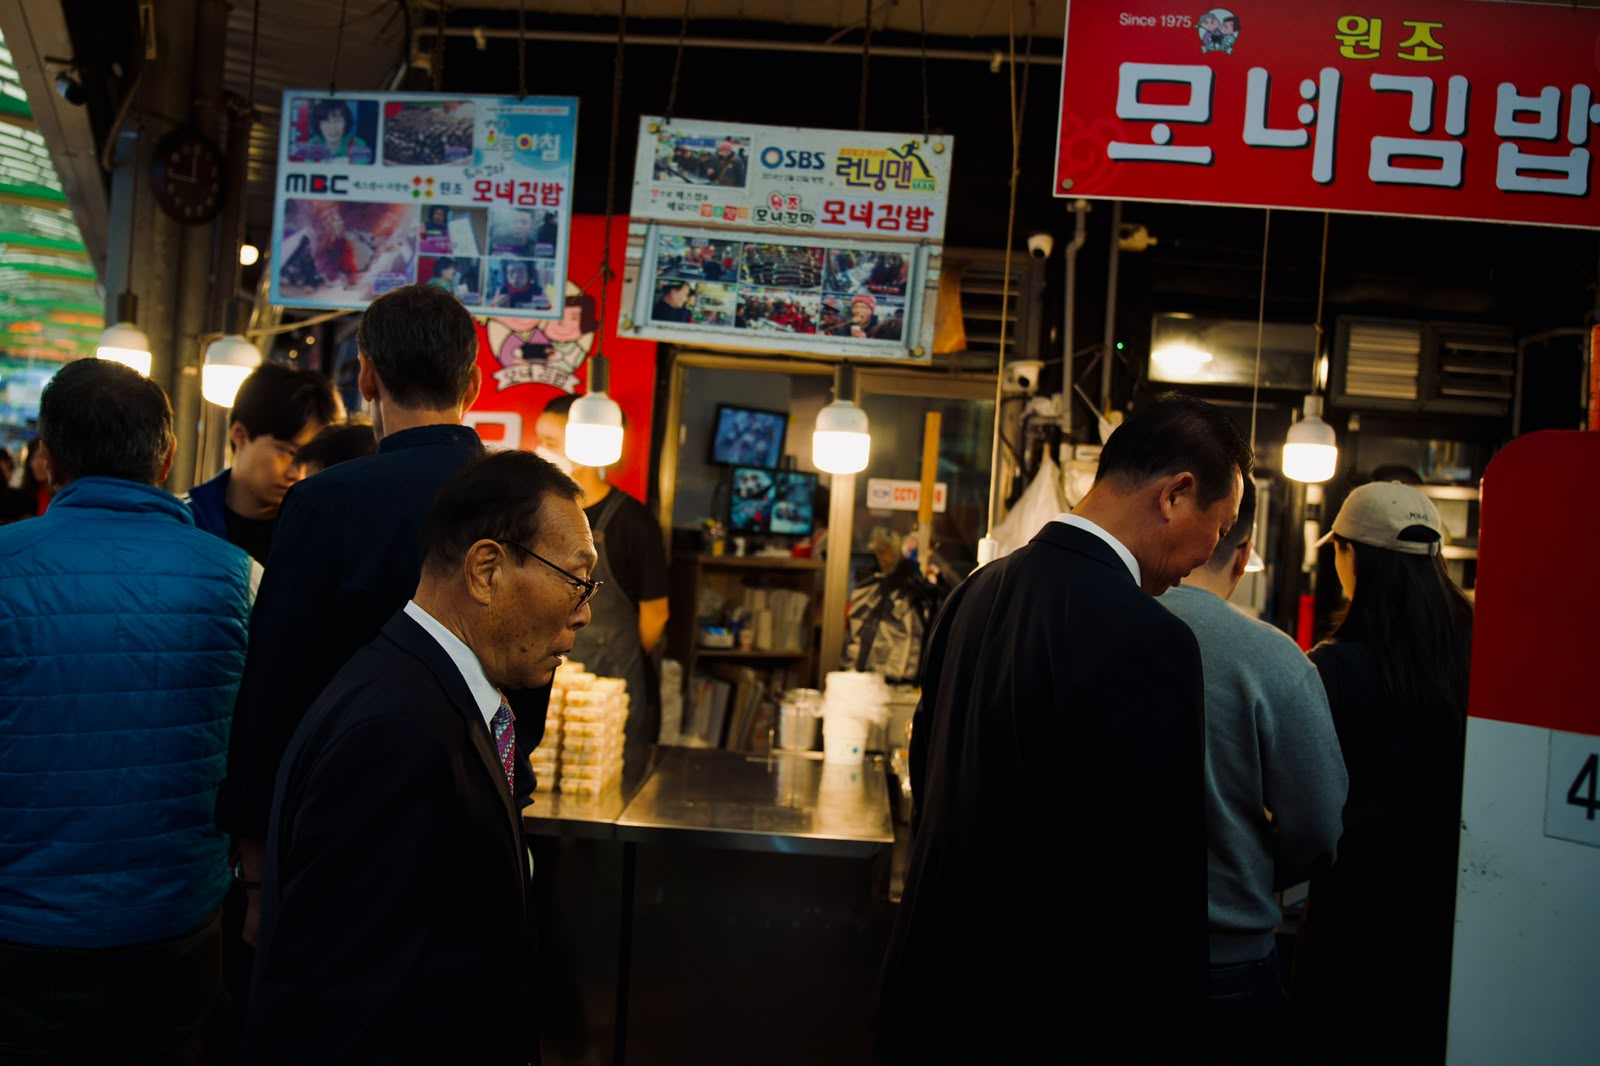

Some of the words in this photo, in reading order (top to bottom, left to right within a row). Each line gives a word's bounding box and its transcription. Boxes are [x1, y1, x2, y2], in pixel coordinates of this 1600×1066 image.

[1119, 12, 1156, 27] Since
[1159, 14, 1192, 28] 1975
[1334, 15, 1445, 61] 원조
[1107, 62, 1600, 196] 모녀김밥
[784, 150, 827, 170] SBS
[836, 157, 913, 191] 런닝맨
[286, 174, 349, 195] MBC
[472, 179, 564, 207] 모녀김밥
[821, 200, 934, 232] 모녀김밥
[1409, 512, 1429, 521] POLO
[1567, 753, 1600, 820] 4
